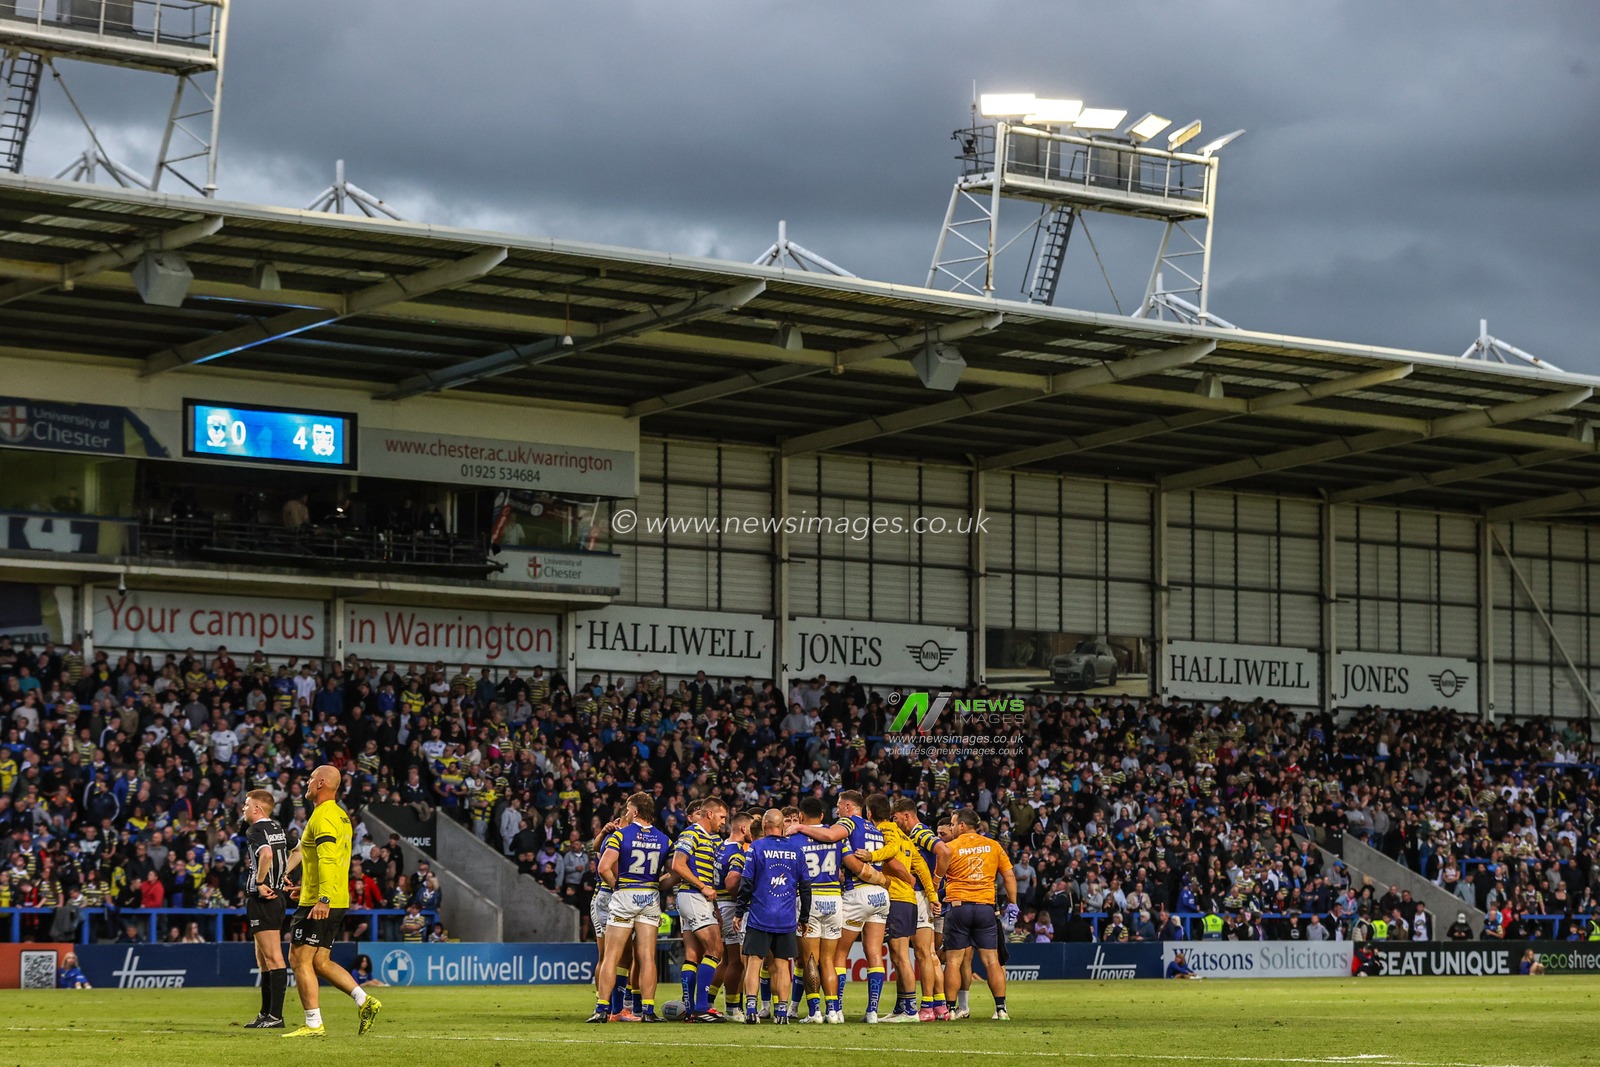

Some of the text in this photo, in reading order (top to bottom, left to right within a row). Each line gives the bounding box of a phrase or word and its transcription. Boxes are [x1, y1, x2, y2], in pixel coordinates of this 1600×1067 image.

[33, 421, 111, 448] Chester
[231, 420, 247, 445] 0
[292, 426, 308, 450] 4
[385, 438, 613, 474] www.chester.ac.uk/warrington
[461, 463, 541, 483] 01925 534684
[543, 566, 583, 579] Chester
[106, 593, 315, 649] Your campus
[349, 610, 552, 660] in Warrington
[587, 620, 762, 659] HALLIWELL
[795, 632, 883, 672] JONES
[922, 651, 939, 661] MINI
[781, 663, 789, 673] K
[1170, 654, 1310, 689] HALLIWELL
[1340, 664, 1409, 699] JONES
[631, 840, 662, 849] THOMAS
[763, 849, 797, 860] WATER
[958, 845, 991, 856] PHYSIO
[628, 849, 660, 875] 21
[804, 850, 837, 878] 34
[770, 876, 788, 886] MK
[112, 947, 187, 988] HOOVER
[427, 955, 592, 983] Halliwell Jones
[1087, 945, 1137, 979] HOOVER
[1172, 946, 1348, 971] Watsons Solicitors
[1378, 951, 1510, 976] SEAT UNIQUE
